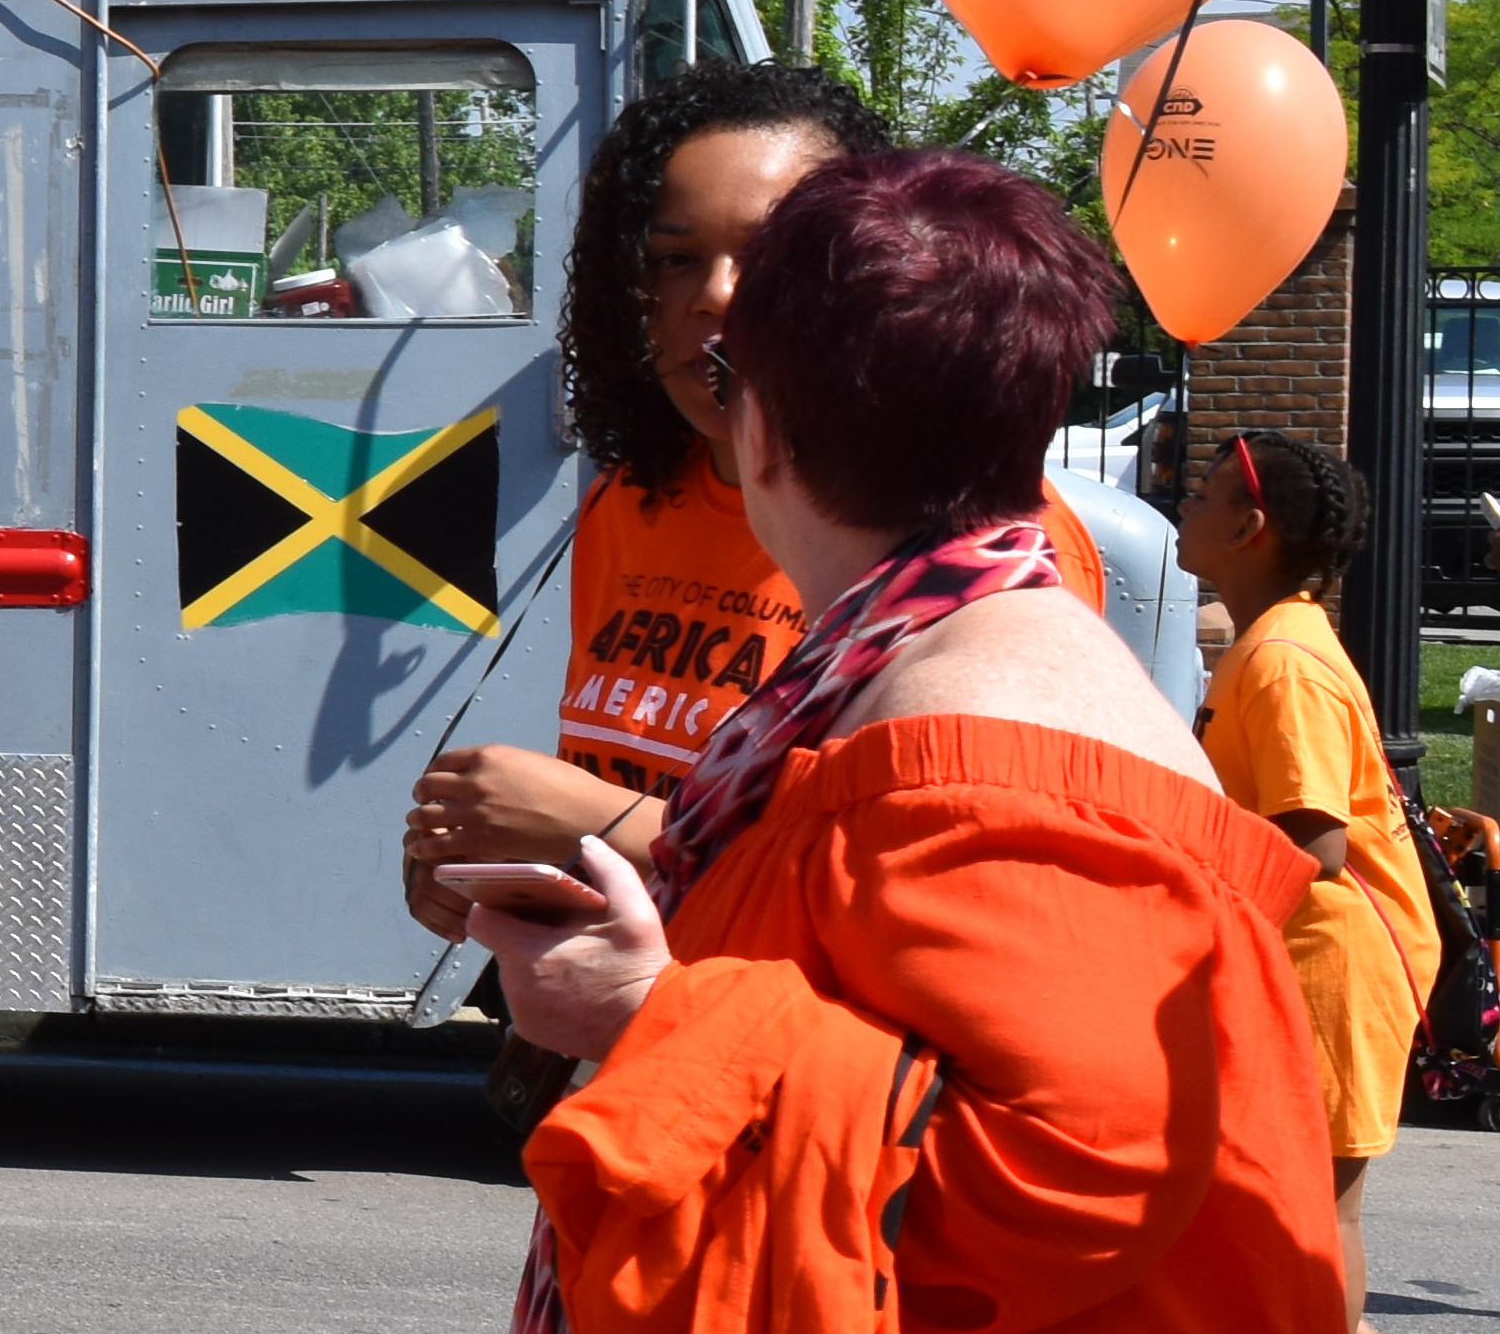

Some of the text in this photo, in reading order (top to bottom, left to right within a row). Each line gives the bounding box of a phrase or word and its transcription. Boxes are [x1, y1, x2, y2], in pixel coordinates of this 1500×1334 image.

[1163, 101, 1194, 113] CND
[649, 574, 684, 604] CITY
[684, 581, 718, 606] OF
[588, 608, 780, 696] AFRICA
